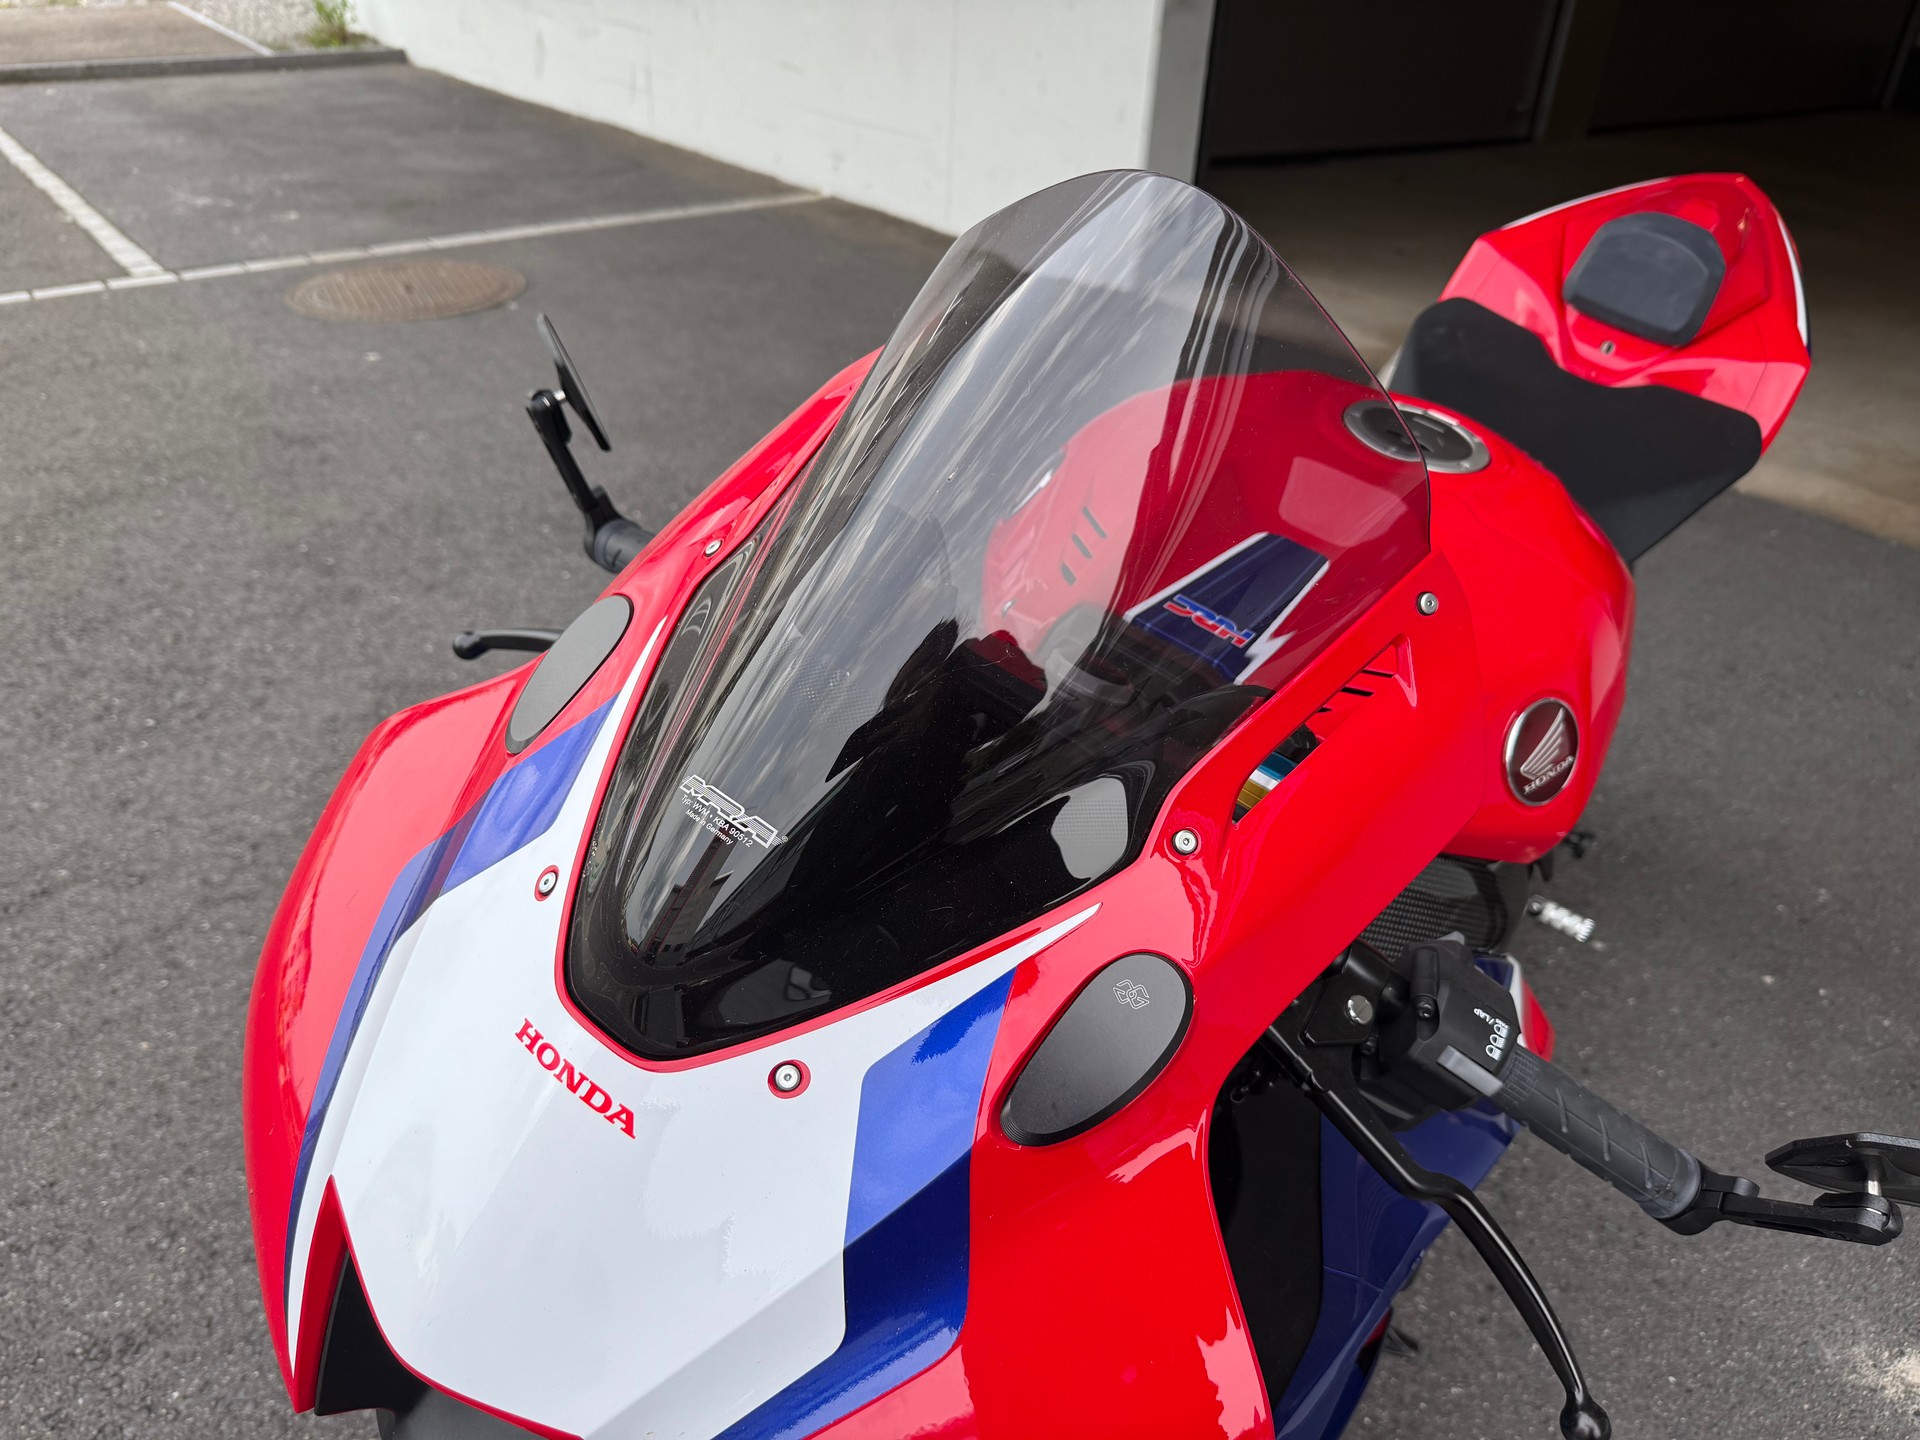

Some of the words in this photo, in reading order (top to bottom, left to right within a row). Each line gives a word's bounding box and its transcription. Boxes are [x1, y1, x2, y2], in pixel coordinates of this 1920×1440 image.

[1163, 593, 1256, 648] HRC
[1523, 755, 1575, 795] HONDA
[685, 808, 701, 822] Made
[699, 818, 706, 827] in
[706, 822, 734, 846] Germany
[693, 800, 711, 818] WVM
[713, 817, 730, 831] KBA
[729, 826, 754, 848] 90512
[515, 1017, 637, 1140] HONDA
